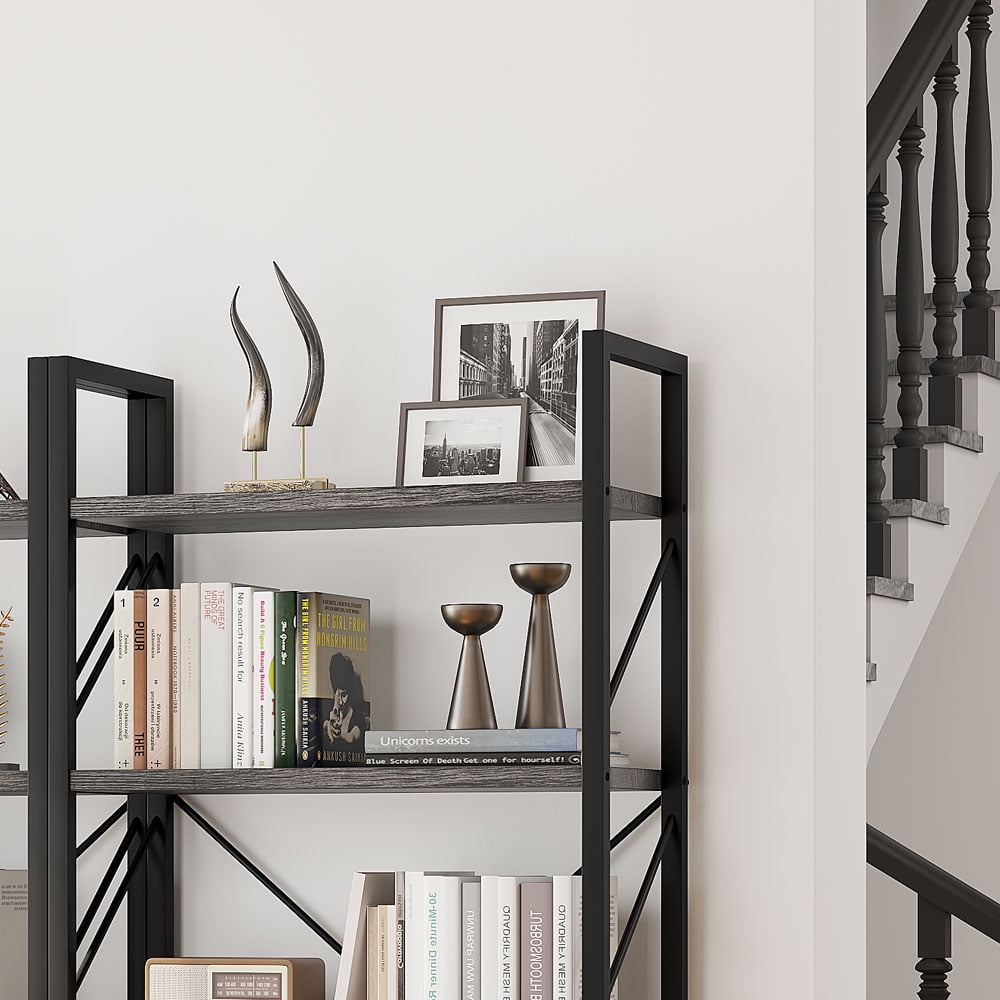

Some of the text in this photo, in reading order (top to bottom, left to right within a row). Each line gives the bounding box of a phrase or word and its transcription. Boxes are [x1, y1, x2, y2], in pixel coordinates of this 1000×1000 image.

[121, 598, 126, 607] 1
[153, 598, 160, 607] 2
[211, 614, 217, 624] OF
[237, 592, 245, 684] No search result for
[134, 621, 144, 757] PUUR THEE
[380, 737, 470, 746] Unicorns exists
